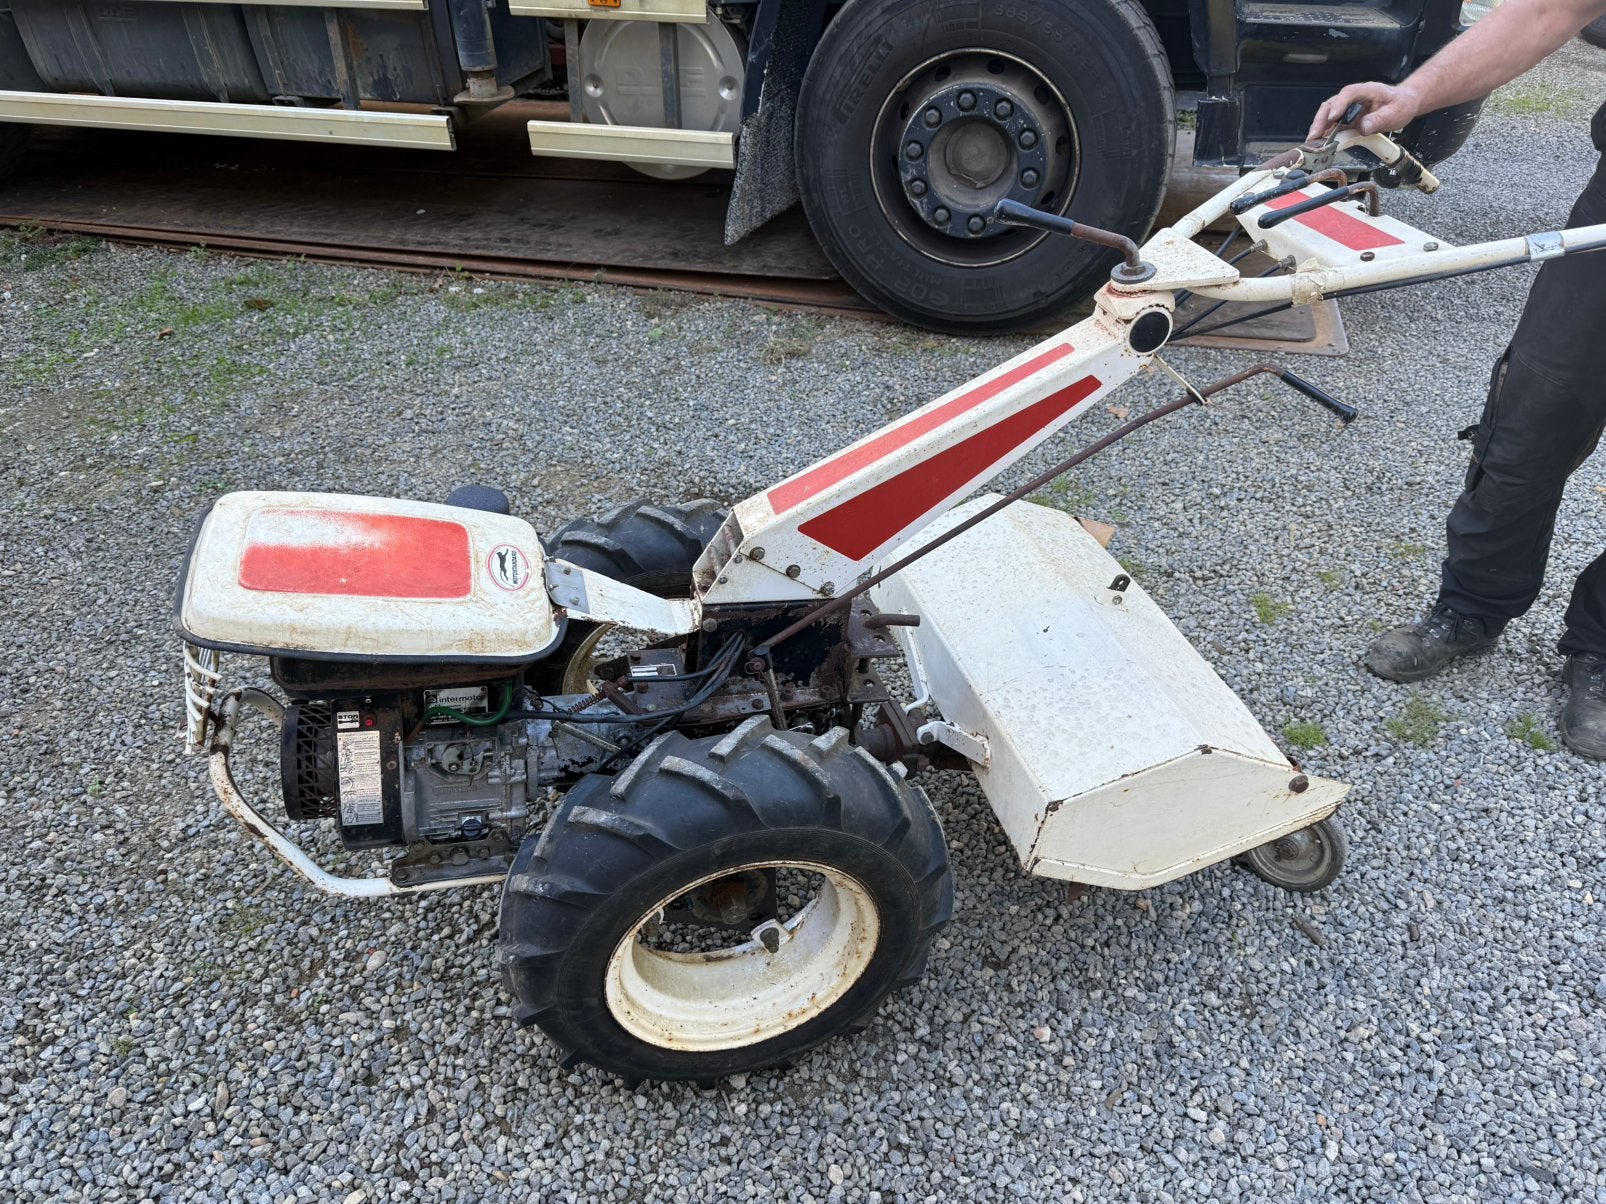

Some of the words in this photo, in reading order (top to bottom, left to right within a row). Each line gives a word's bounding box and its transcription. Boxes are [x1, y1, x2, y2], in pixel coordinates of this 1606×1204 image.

[830, 34, 893, 124] PIRELLI
[511, 549, 519, 586] MOTOSTANDARD
[438, 694, 486, 704] intermotor
